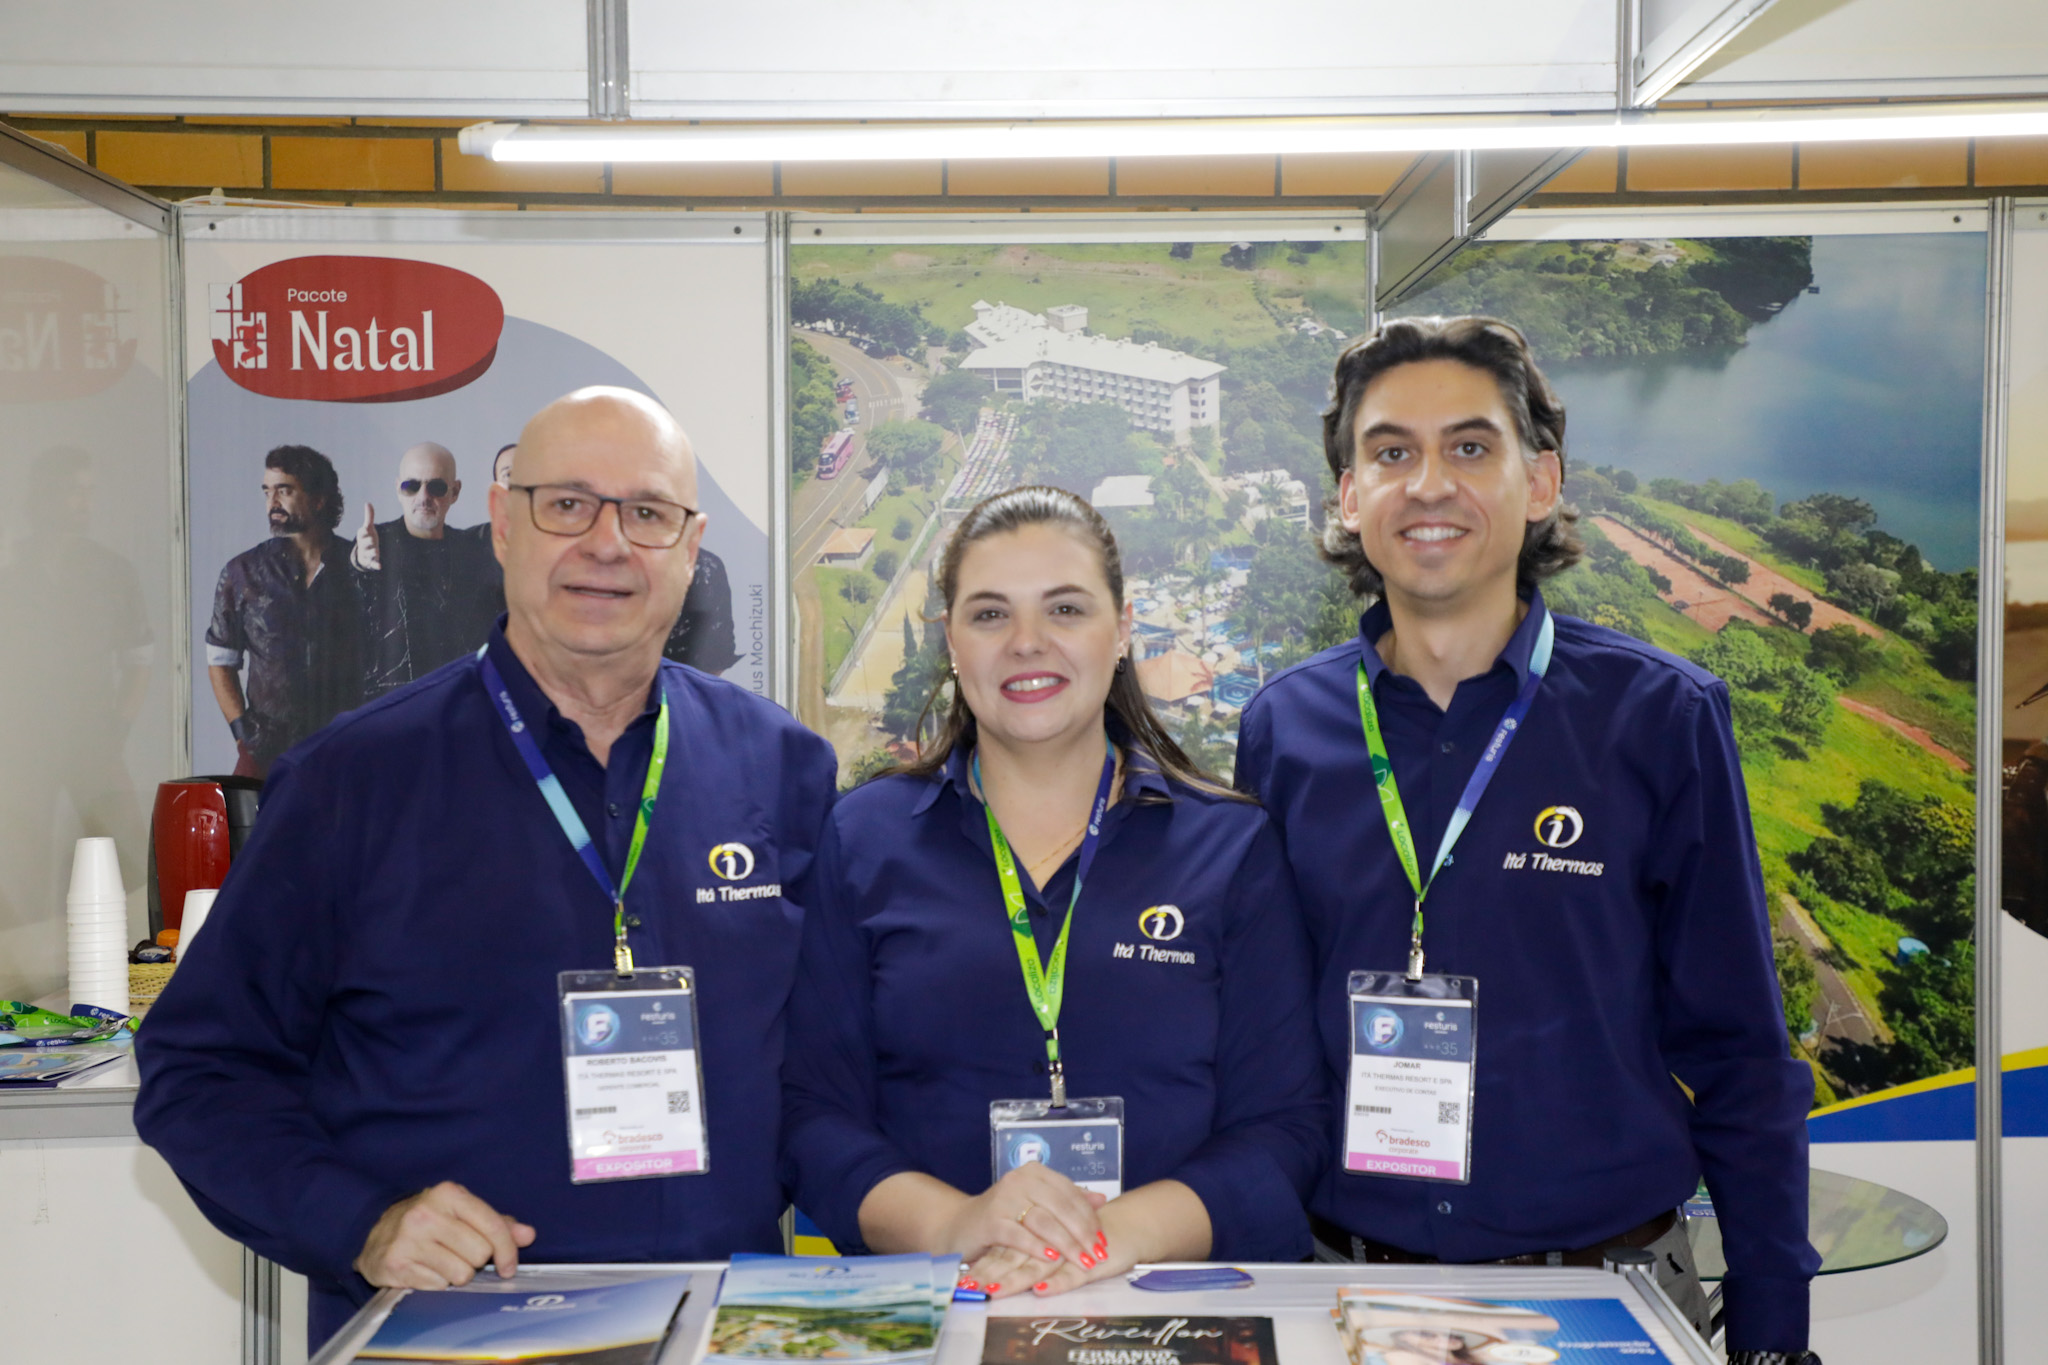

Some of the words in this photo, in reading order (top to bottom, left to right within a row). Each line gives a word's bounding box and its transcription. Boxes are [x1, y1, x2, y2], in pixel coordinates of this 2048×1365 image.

[287, 288, 348, 303] Pacote
[288, 309, 436, 372] Natal
[749, 584, 764, 665] Mochizuki
[1502, 851, 1528, 870] Itá
[1531, 852, 1605, 877] Thermas
[695, 887, 716, 905] Itá
[717, 883, 782, 902] Thermas
[1112, 941, 1136, 959] Itá
[1138, 943, 1196, 965] Thermas
[659, 1031, 679, 1046] 35
[1440, 1041, 1458, 1056] 35
[586, 1057, 627, 1066] ROBERTO
[1393, 1061, 1421, 1070] JOMAR
[1373, 1072, 1404, 1081] THERMAS
[1405, 1075, 1432, 1084] RESORT
[1439, 1078, 1453, 1086] SPA
[1374, 1085, 1405, 1094] EXECUTIVO
[617, 1132, 664, 1144] bradesco
[1388, 1135, 1431, 1148] bradesco
[595, 1158, 673, 1174] EXPOSITOR
[1087, 1161, 1106, 1176] 35
[1366, 1159, 1437, 1176] EXPOSITOR
